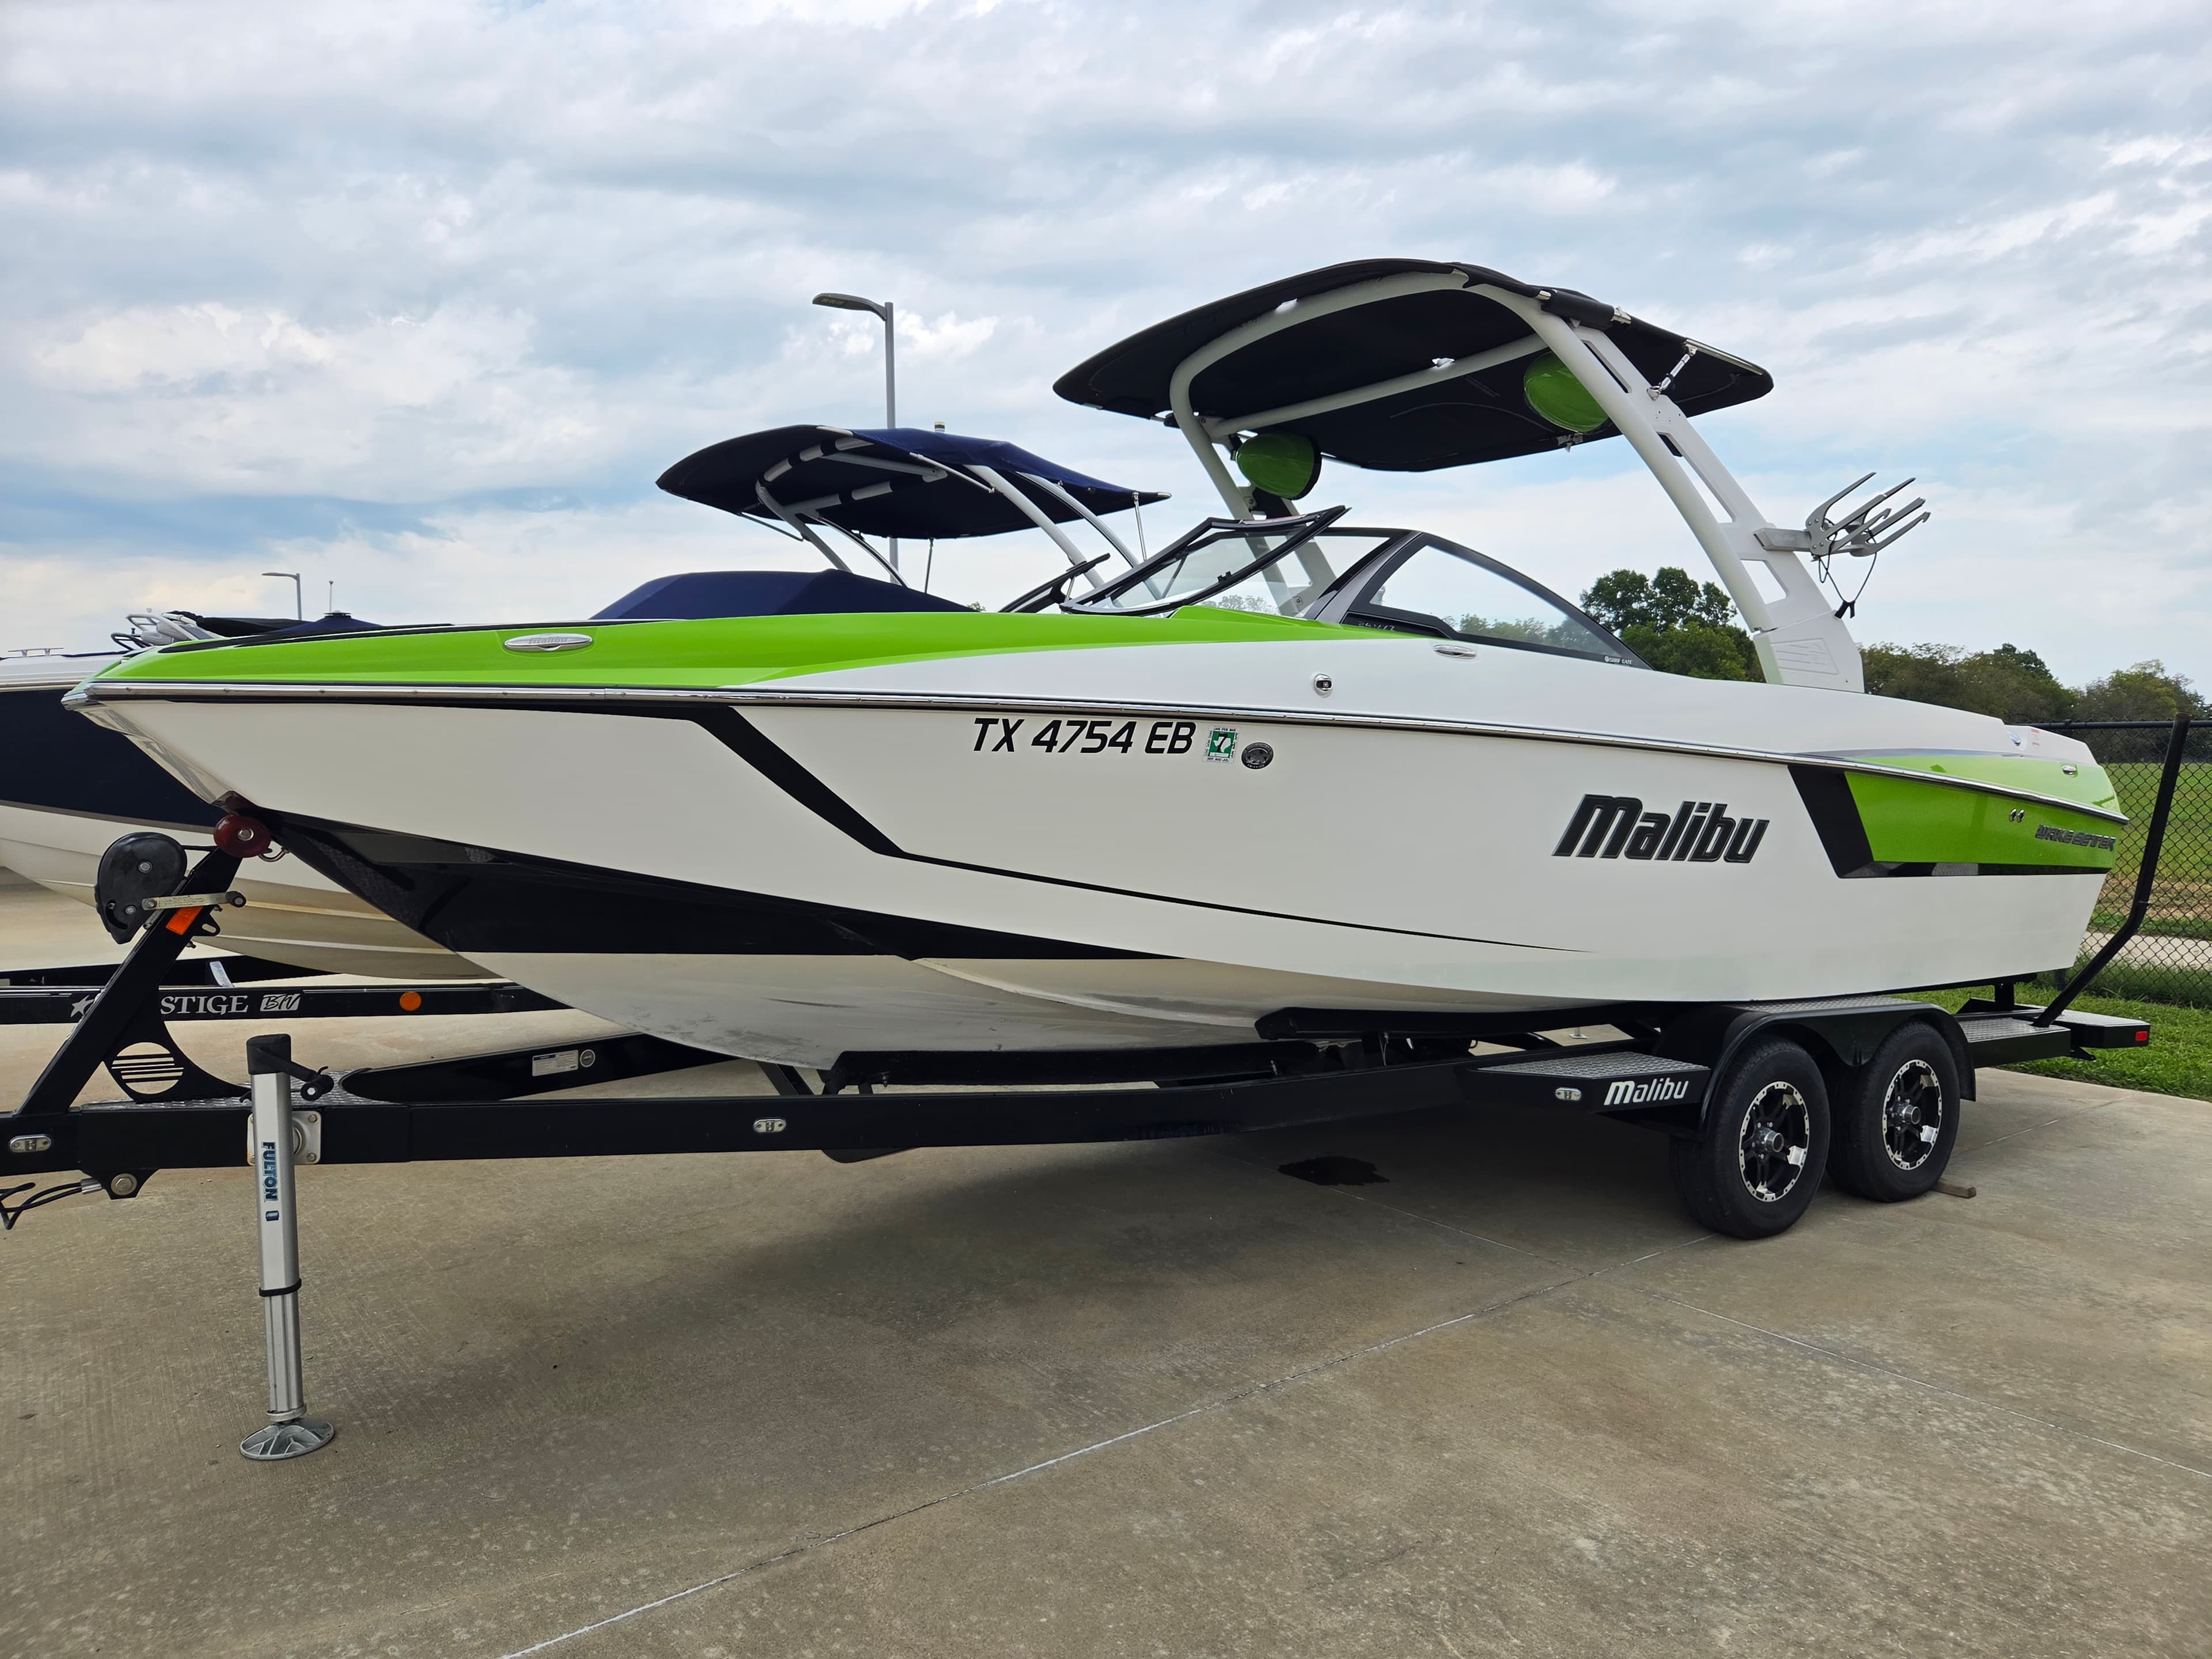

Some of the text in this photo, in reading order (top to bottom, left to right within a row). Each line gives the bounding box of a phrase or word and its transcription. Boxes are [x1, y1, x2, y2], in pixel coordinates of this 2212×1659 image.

[973, 717, 1025, 752] TX
[1031, 720, 1138, 754] 4754
[1145, 721, 1196, 754] EB
[1551, 793, 1770, 863] Malibu
[160, 995, 248, 1015] STIGE
[1604, 1077, 1689, 1105] Malibu
[261, 1141, 279, 1202] FULTON
